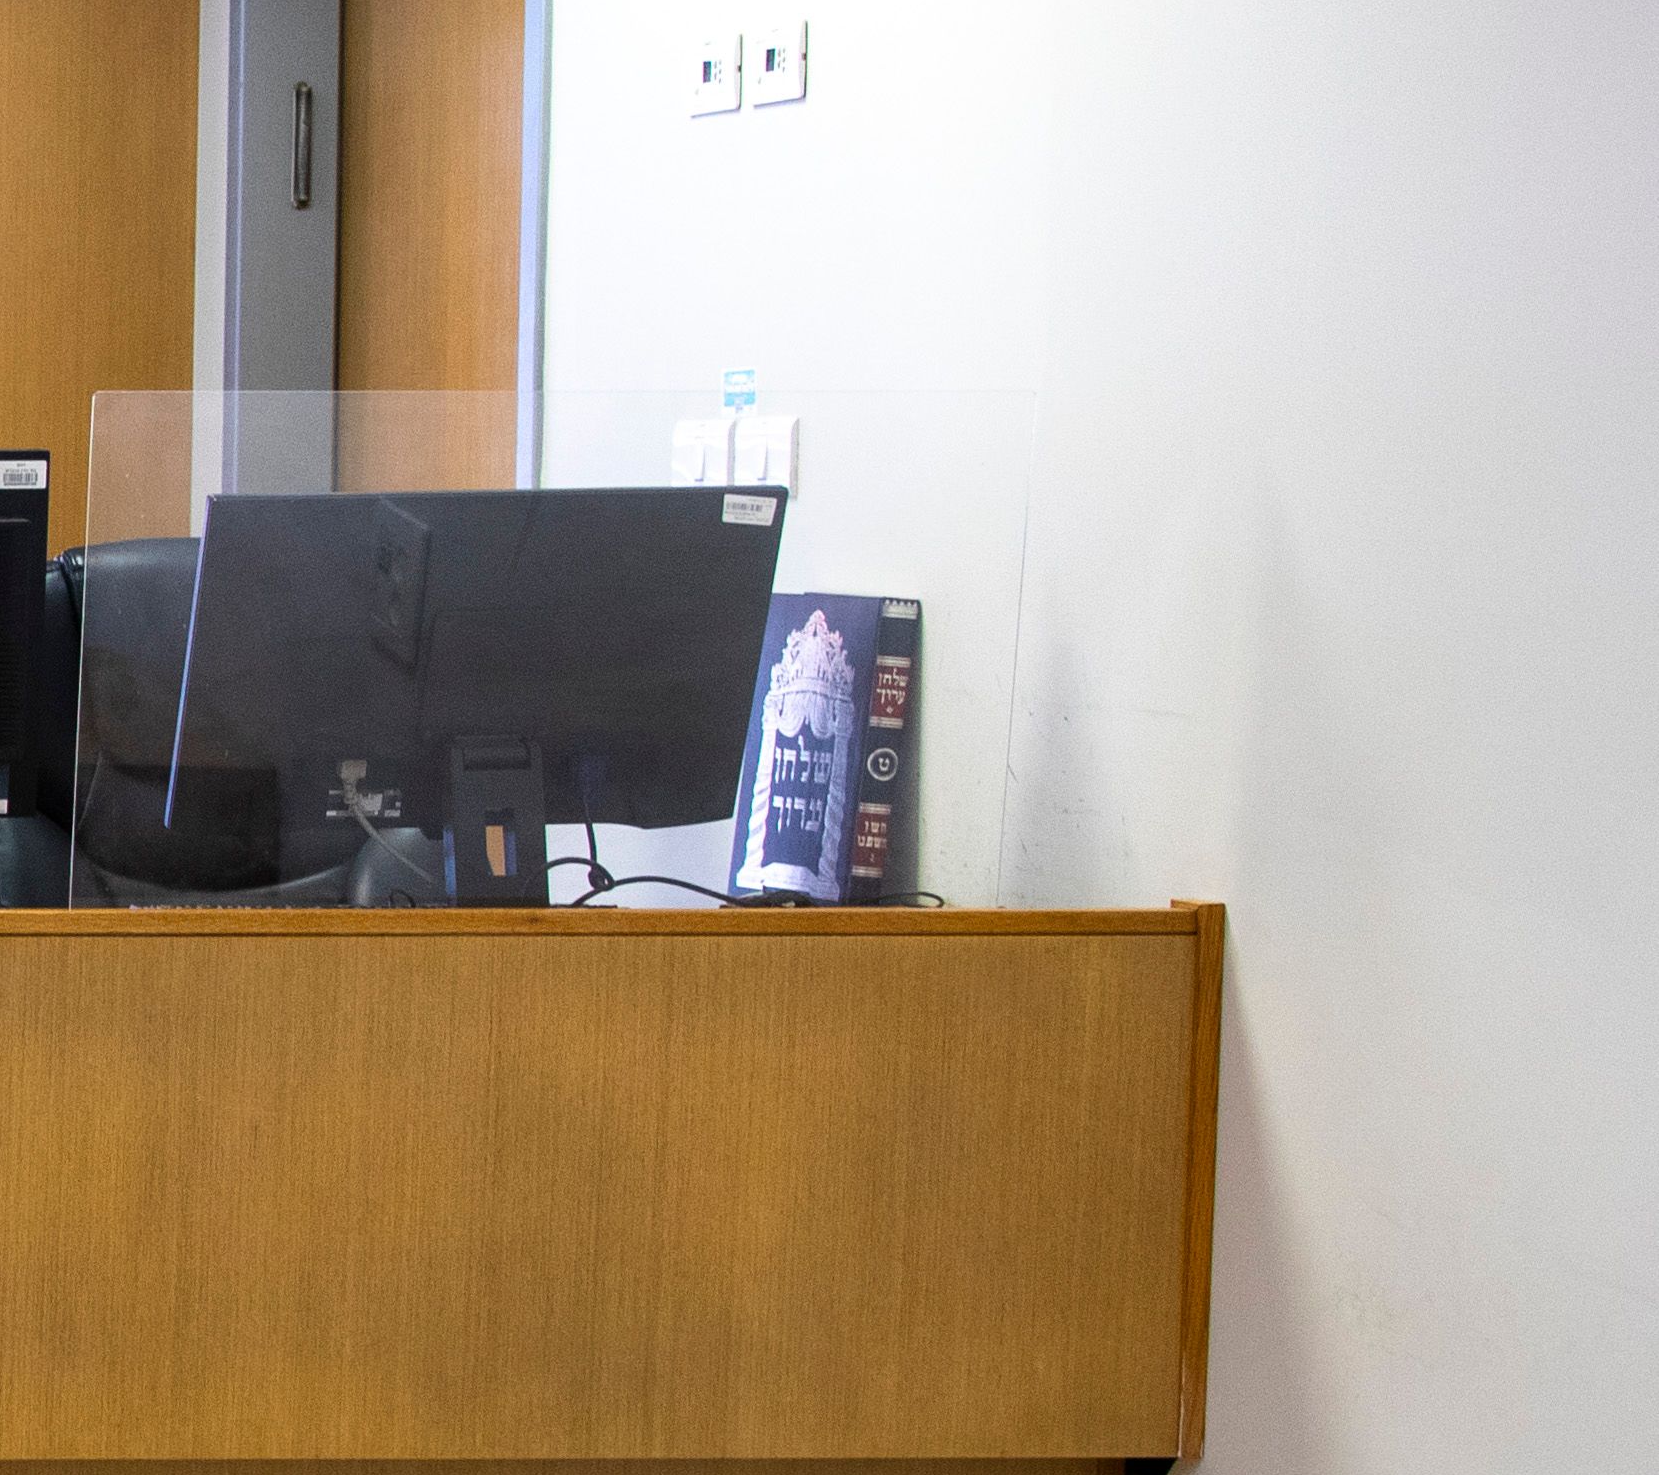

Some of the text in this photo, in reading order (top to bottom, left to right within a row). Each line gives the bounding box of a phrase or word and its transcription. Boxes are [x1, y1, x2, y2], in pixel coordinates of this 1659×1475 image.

[877, 667, 910, 687] שלחן
[875, 688, 907, 706] ערוך
[774, 734, 833, 784] שלחן
[772, 794, 823, 834] ערוך
